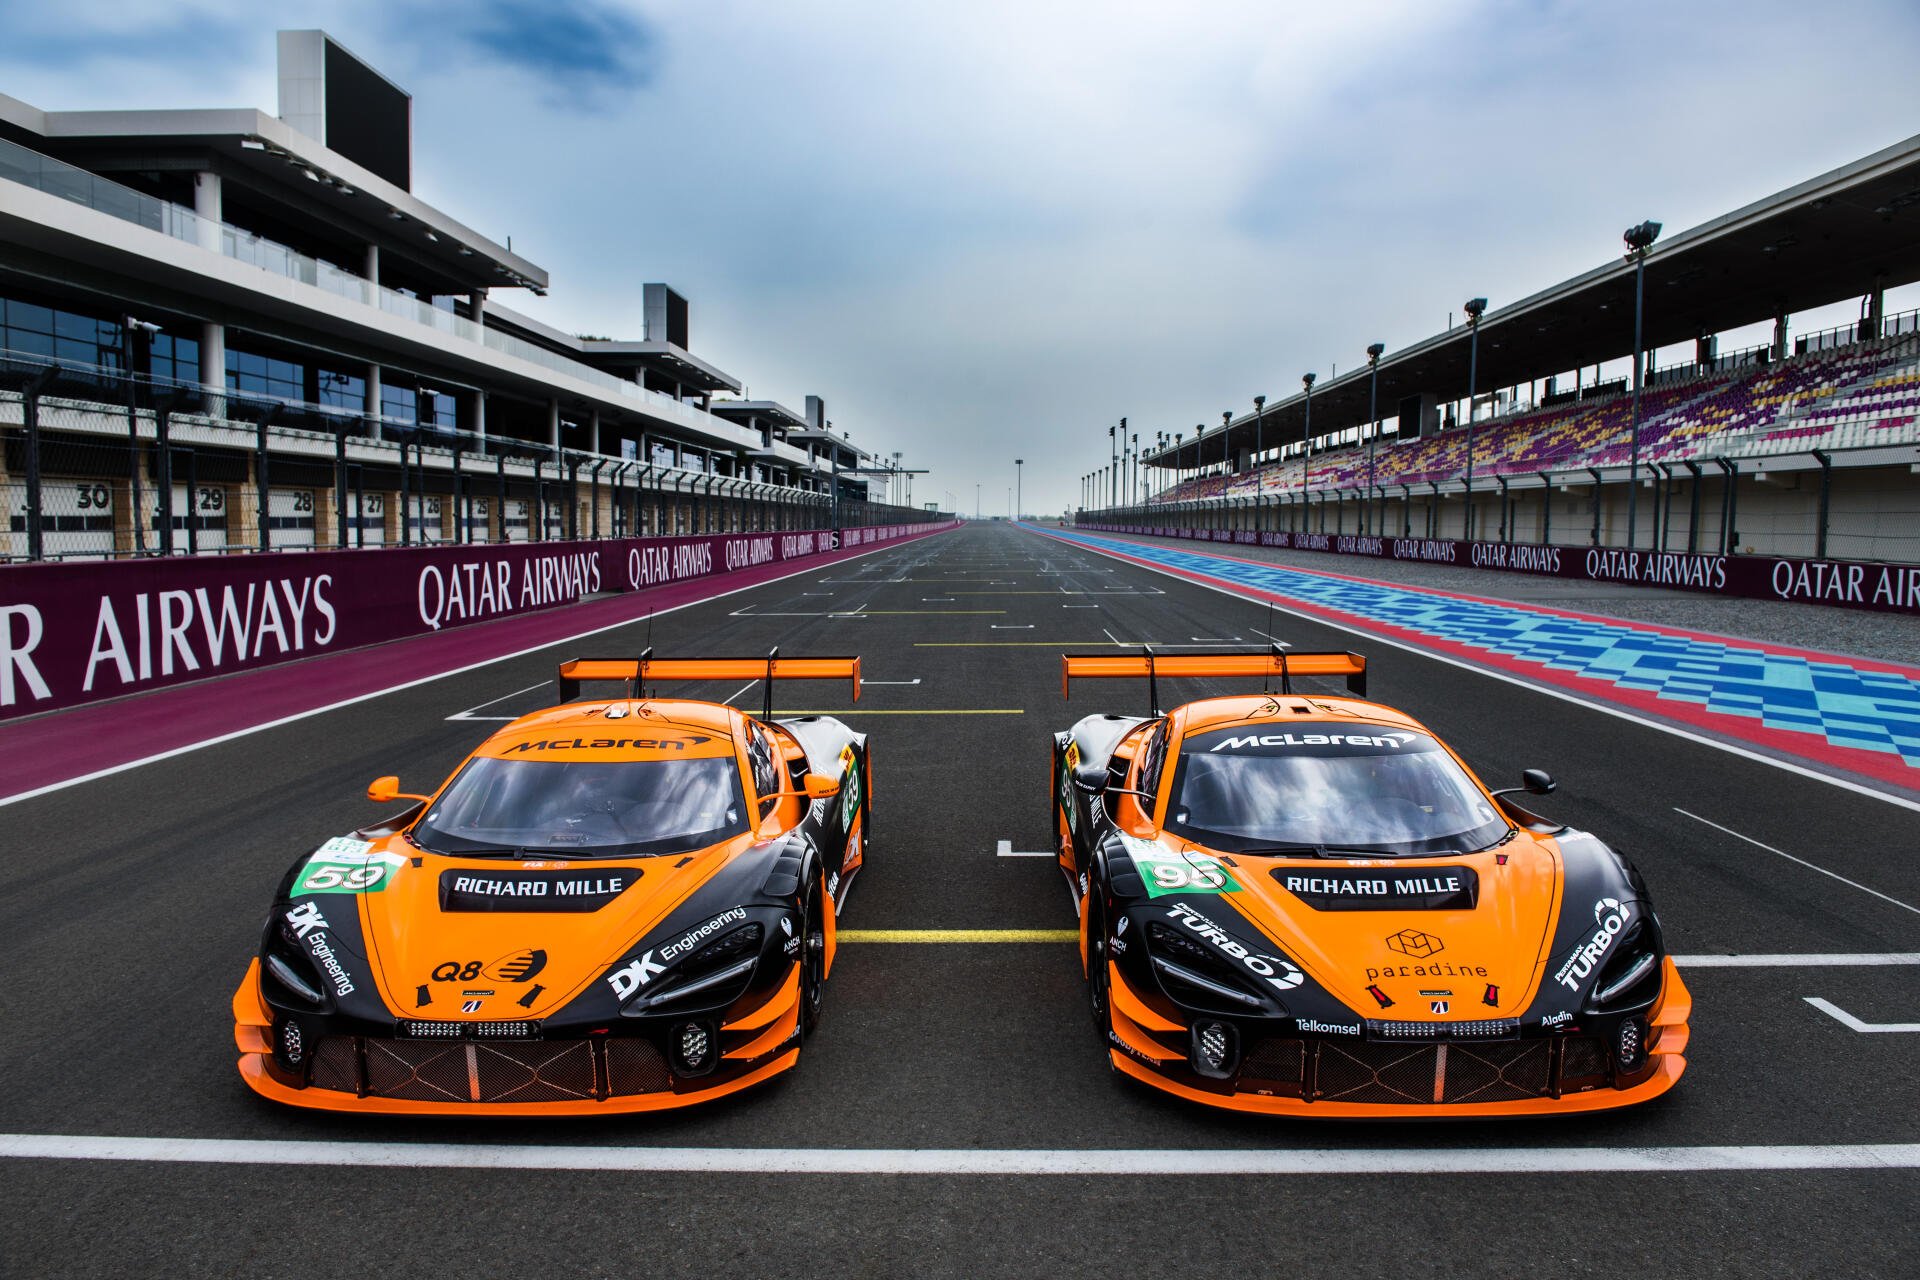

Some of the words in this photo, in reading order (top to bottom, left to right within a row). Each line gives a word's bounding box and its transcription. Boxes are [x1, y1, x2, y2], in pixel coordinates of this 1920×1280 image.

[77, 484, 109, 509] 30
[200, 488, 223, 510] 29
[294, 492, 312, 512] 28
[367, 495, 382, 513] 27
[726, 540, 748, 571] QATAR
[750, 537, 773, 565] AIRWAYS
[1337, 536, 1356, 553] QATAR
[1357, 537, 1383, 556] AIRWAYS
[1394, 539, 1419, 559] QATAR
[1420, 540, 1456, 562] AIRWAYS
[1472, 543, 1506, 567] QATAR
[1509, 546, 1560, 573] AIRWAYS
[629, 547, 670, 590] QATAR
[672, 542, 712, 579] AIRWAYS
[1586, 550, 1639, 580] QATAR
[1643, 553, 1726, 589] AIRWAYS
[418, 560, 512, 630] QATAR
[520, 551, 601, 608] AIRWAYS
[1772, 561, 1864, 602] QATAR
[0, 604, 52, 706] R
[82, 574, 336, 692] AIRWAYS
[848, 769, 858, 811] 59
[303, 866, 387, 890] 59
[454, 876, 548, 896] RICHARD
[555, 877, 622, 896] MILLE
[1153, 864, 1226, 890] 95
[1287, 876, 1388, 895] RICHARD
[1395, 877, 1461, 895] MILLE
[285, 901, 330, 939] DK
[607, 950, 667, 1001] DK
[660, 905, 747, 961] Engineering
[1166, 908, 1275, 976] TURBO
[1561, 914, 1622, 992] TURBO
[308, 931, 355, 997] Engineering
[431, 960, 483, 982] Q8
[1366, 962, 1488, 982] paradine
[1296, 1018, 1360, 1035] Telkomsel
[1542, 1011, 1574, 1027] Aladin
